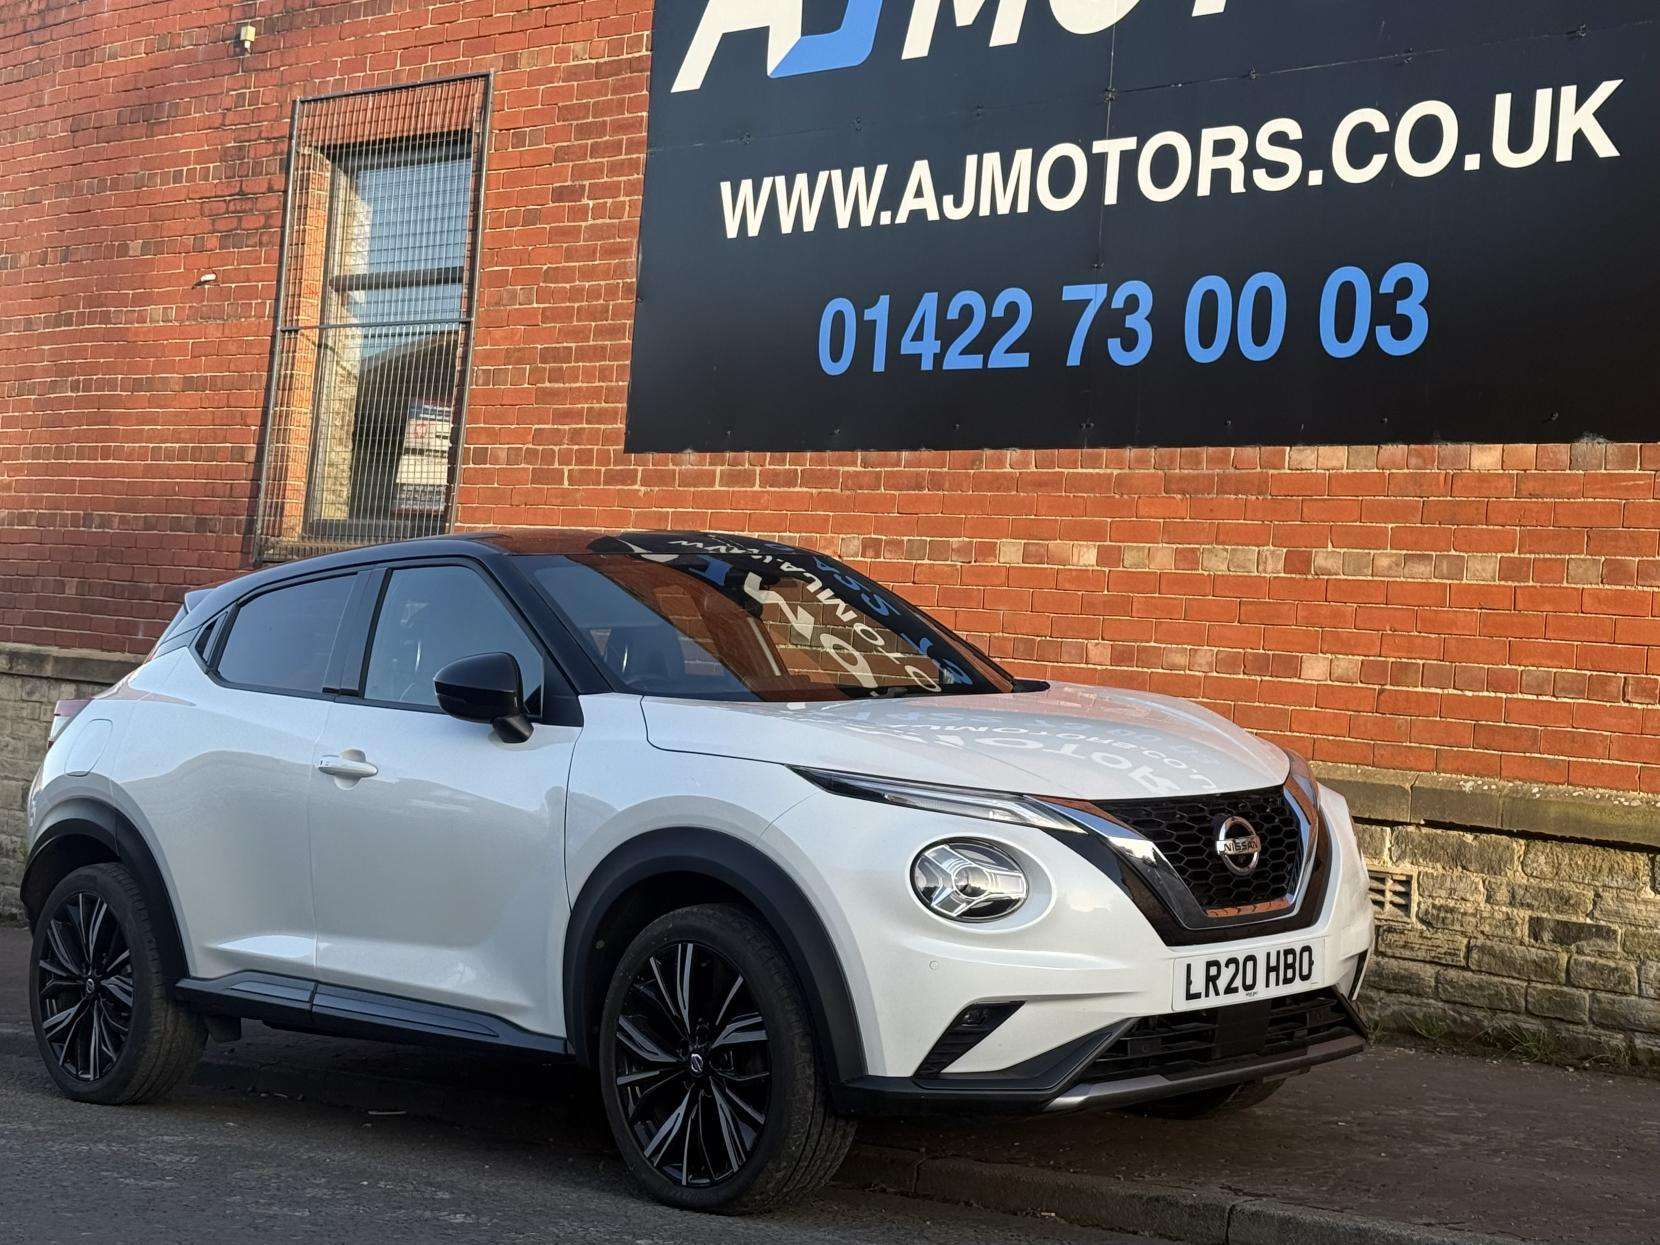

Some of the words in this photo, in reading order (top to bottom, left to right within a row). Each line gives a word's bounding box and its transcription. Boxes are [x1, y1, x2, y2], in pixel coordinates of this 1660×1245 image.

[719, 78, 1624, 239] WWW.AJMOTORS.CO.UK
[818, 287, 1033, 376] 01422
[1061, 280, 1153, 367] 73
[1184, 271, 1287, 364] 00
[1319, 262, 1429, 358] 03
[1224, 839, 1258, 851] NISSAN
[1185, 954, 1258, 1001] LR20
[1265, 945, 1314, 988] HBO
